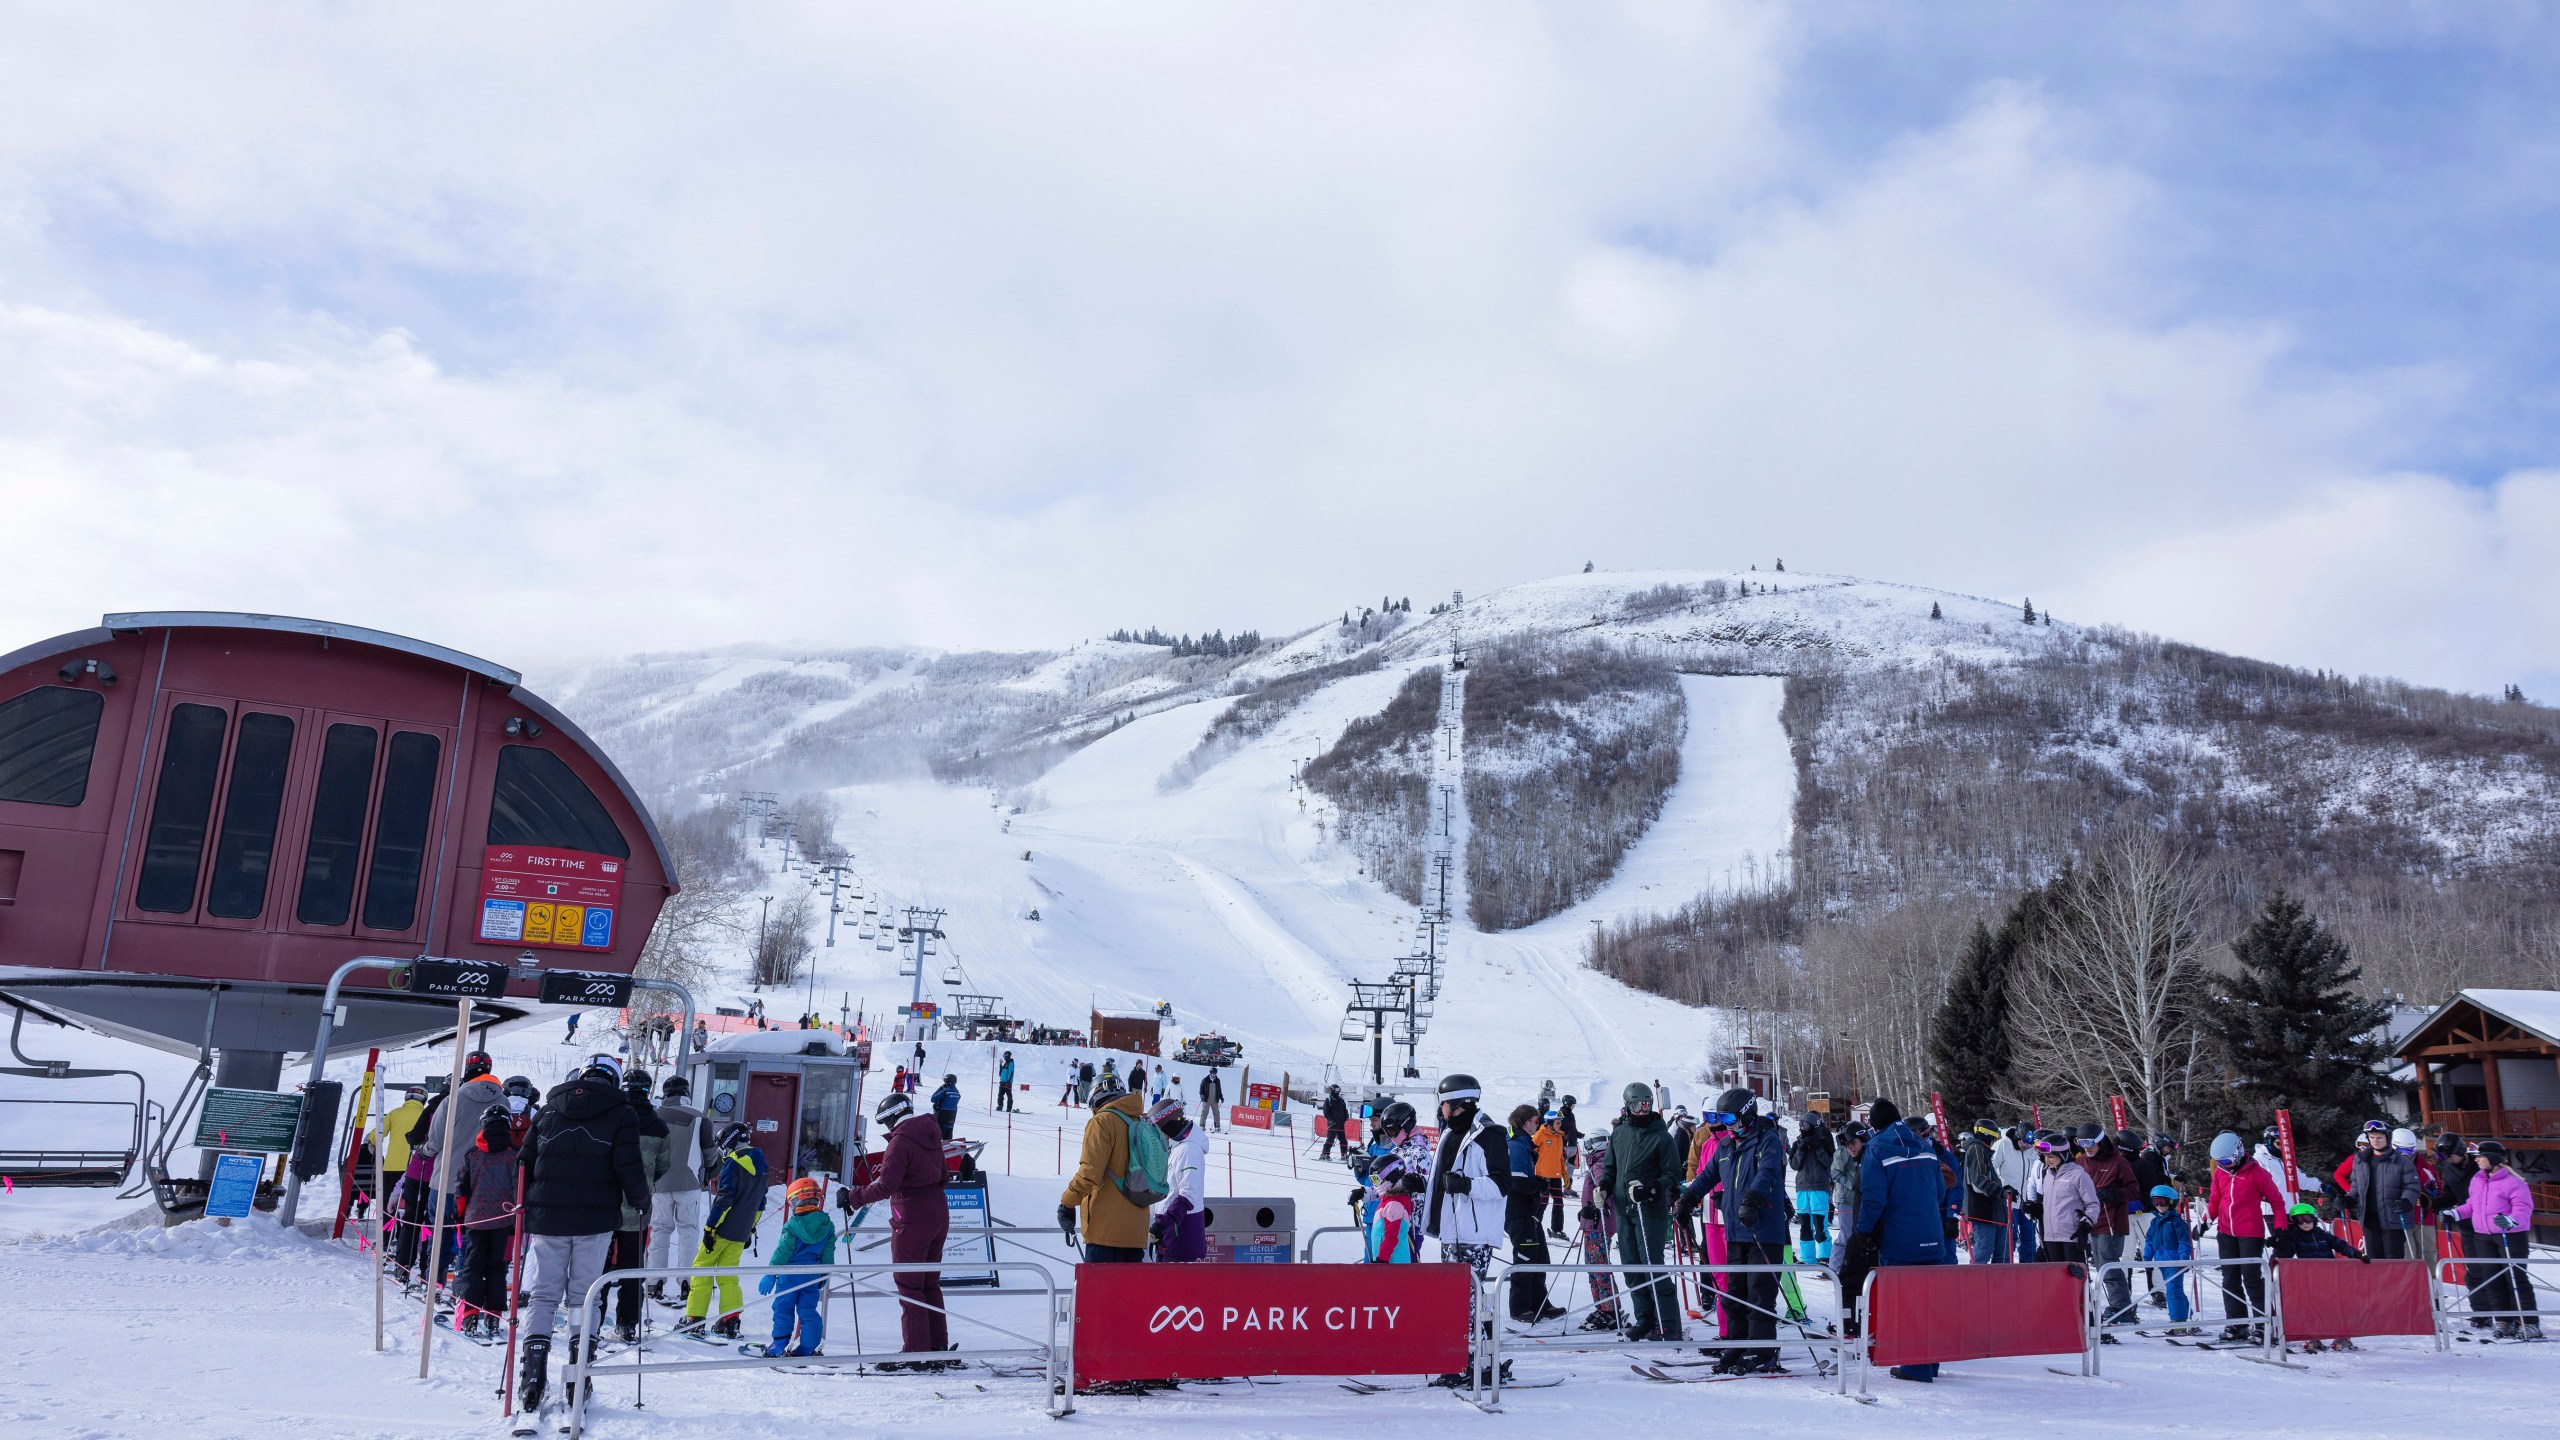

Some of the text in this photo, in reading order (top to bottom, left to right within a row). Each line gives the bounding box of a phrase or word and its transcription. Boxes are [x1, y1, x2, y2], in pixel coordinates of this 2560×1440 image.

[527, 856, 585, 869] FIRST TIME
[429, 984, 457, 992] PARK
[2280, 1118, 2294, 1181] ALTERNATE
[1222, 1306, 1400, 1331] PARK CITY
